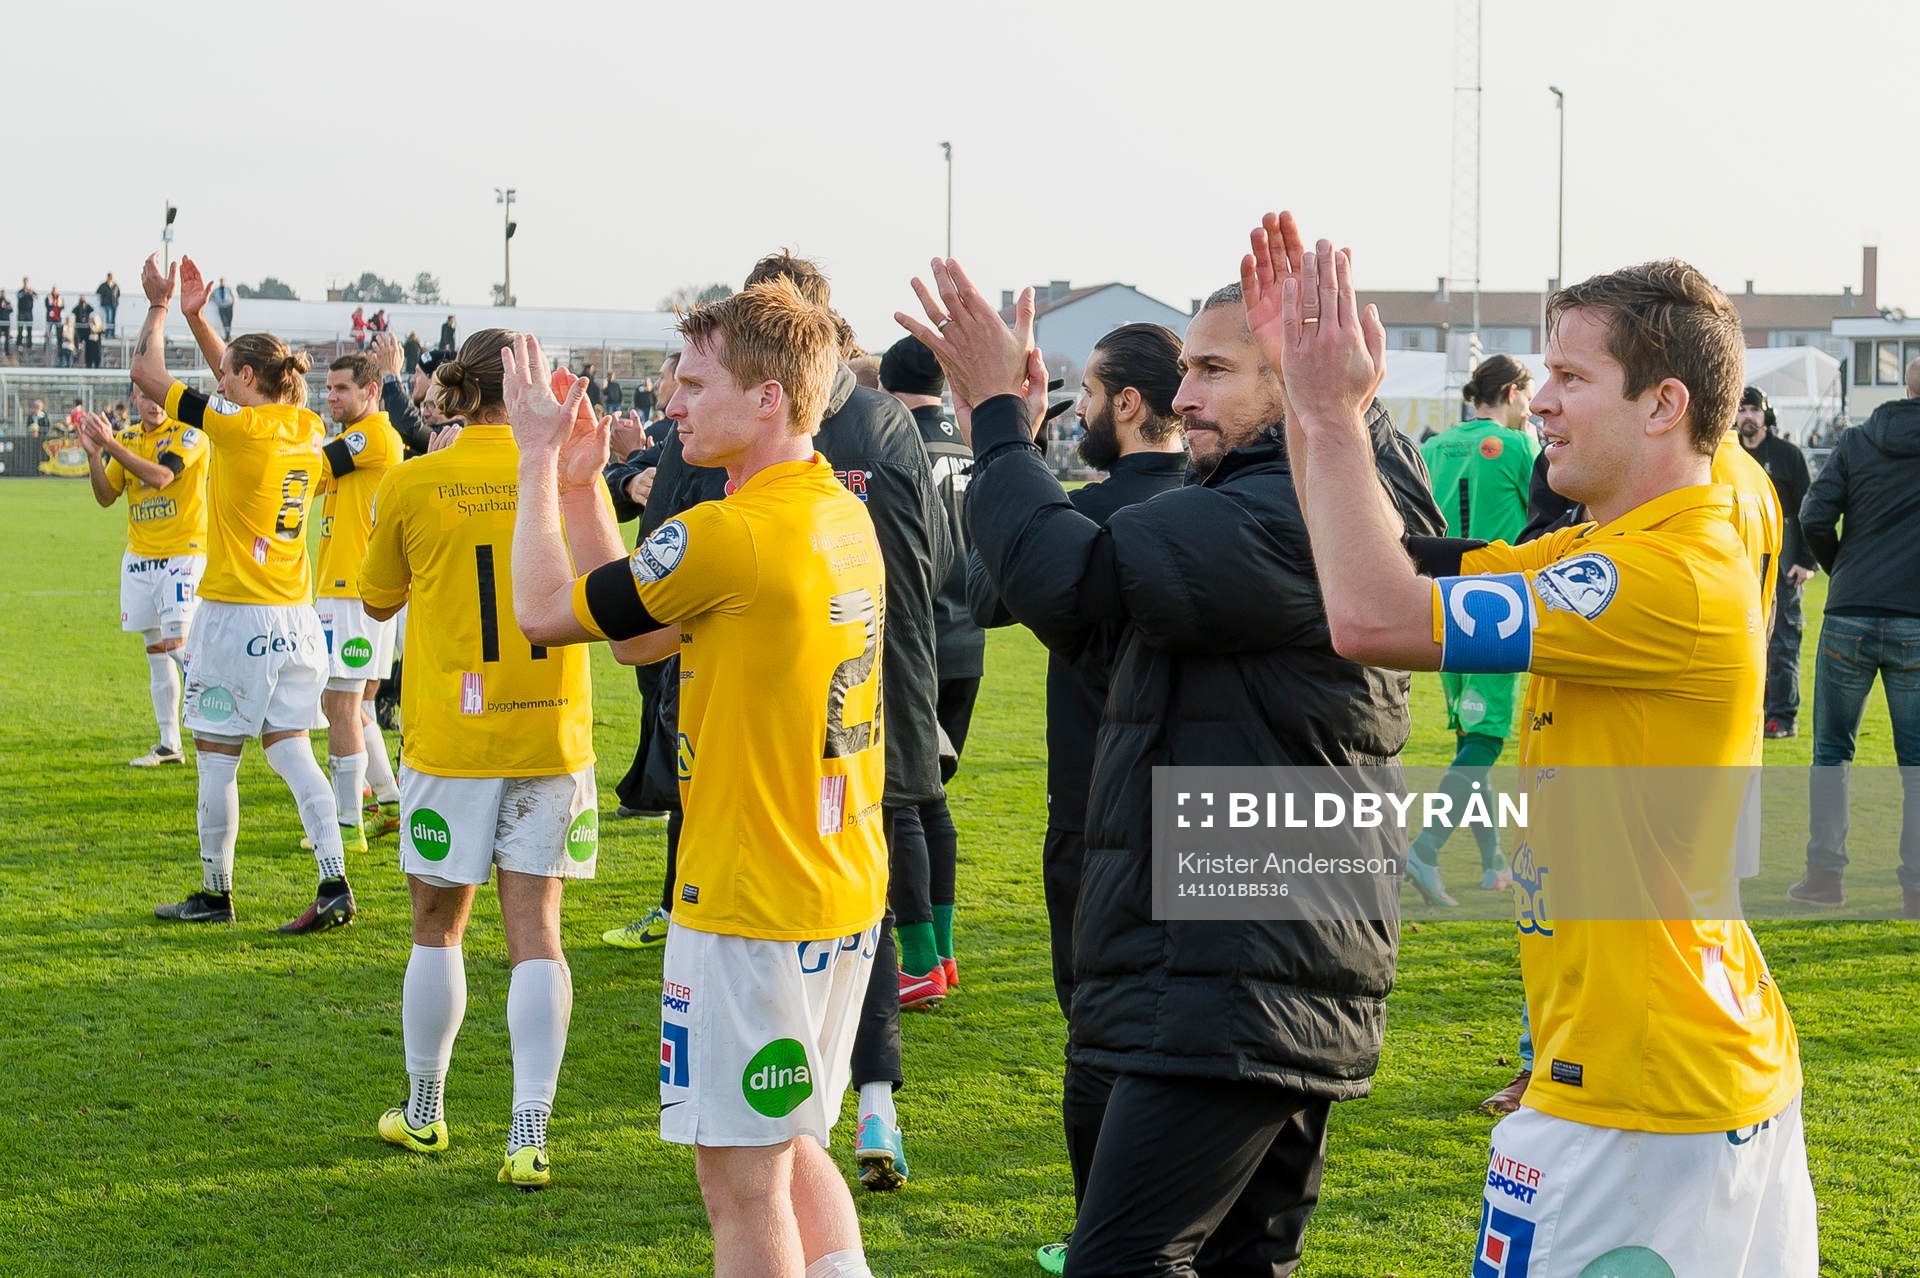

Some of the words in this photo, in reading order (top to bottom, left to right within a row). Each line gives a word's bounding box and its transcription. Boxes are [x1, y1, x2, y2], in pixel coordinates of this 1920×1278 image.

[436, 482, 518, 501] Falkenberg
[275, 469, 309, 540] 8
[457, 499, 516, 517] Sparban
[640, 547, 666, 577] ALCON
[1450, 579, 1523, 640] C
[343, 644, 369, 659] dina
[202, 697, 232, 712] dina
[487, 697, 569, 713] bygghemma.se
[413, 823, 448, 843] dina
[570, 825, 597, 843] dina
[664, 981, 691, 1001] NTER
[750, 1064, 810, 1091] dina
[1491, 1151, 1541, 1188] INTER
[1488, 1169, 1537, 1206] SPORT
